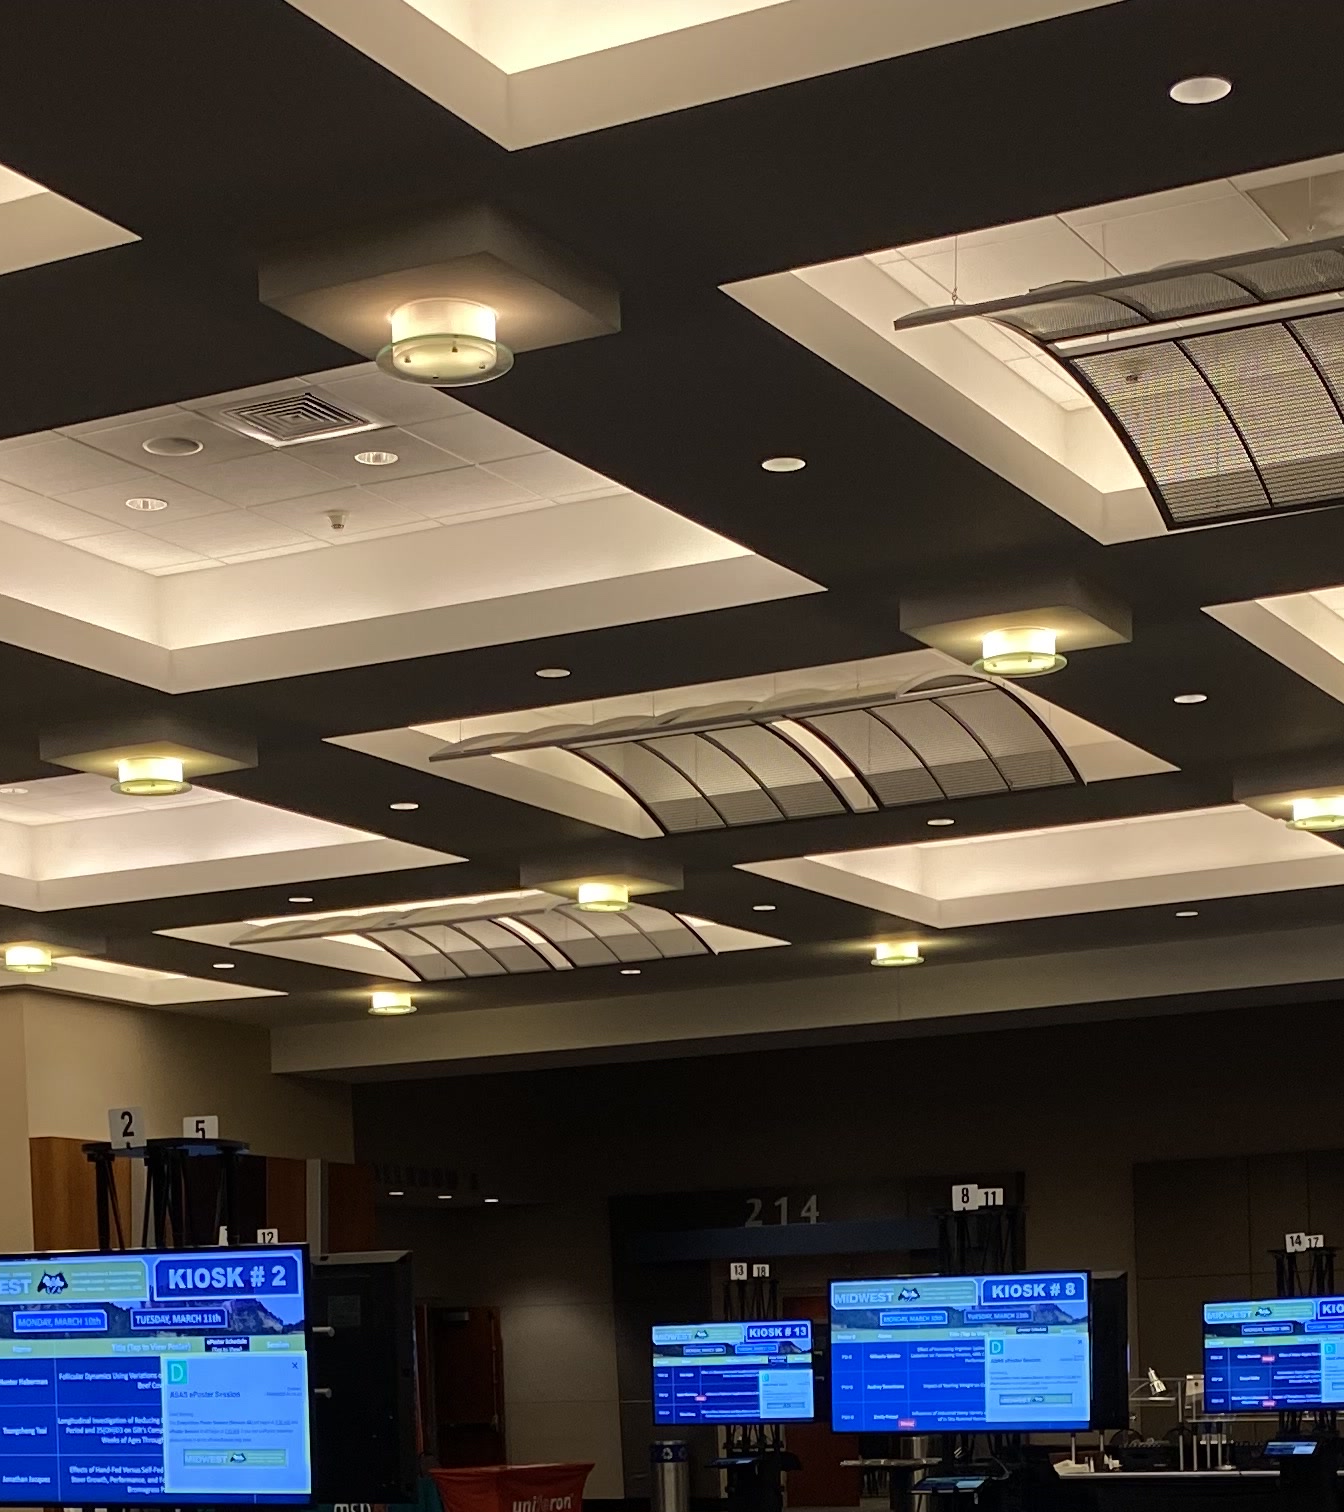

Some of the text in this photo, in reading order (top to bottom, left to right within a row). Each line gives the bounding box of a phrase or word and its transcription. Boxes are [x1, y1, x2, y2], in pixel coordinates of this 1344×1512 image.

[121, 1111, 134, 1137] 2
[195, 1119, 205, 1139] 5
[962, 1187, 969, 1203] 8
[984, 1191, 996, 1206] 11
[745, 1194, 820, 1228] 214
[261, 1232, 274, 1244] 12
[1290, 1235, 1301, 1246] 14
[1308, 1237, 1319, 1248] 17
[734, 1265, 744, 1275] 13
[757, 1267, 766, 1277] 18
[168, 1266, 245, 1290] KIOSK
[249, 1266, 265, 1287] #
[271, 1265, 287, 1286] 2
[992, 1282, 1076, 1298] KIOSK # 8
[835, 1292, 894, 1304] MIDWEST
[18, 1317, 102, 1328] MONDAY, MARCH 10th
[135, 1312, 221, 1326] TUESDAY, MARCH 11th
[749, 1327, 782, 1338] KIOSK
[794, 1326, 807, 1336] 13
[171, 1363, 184, 1382] D
